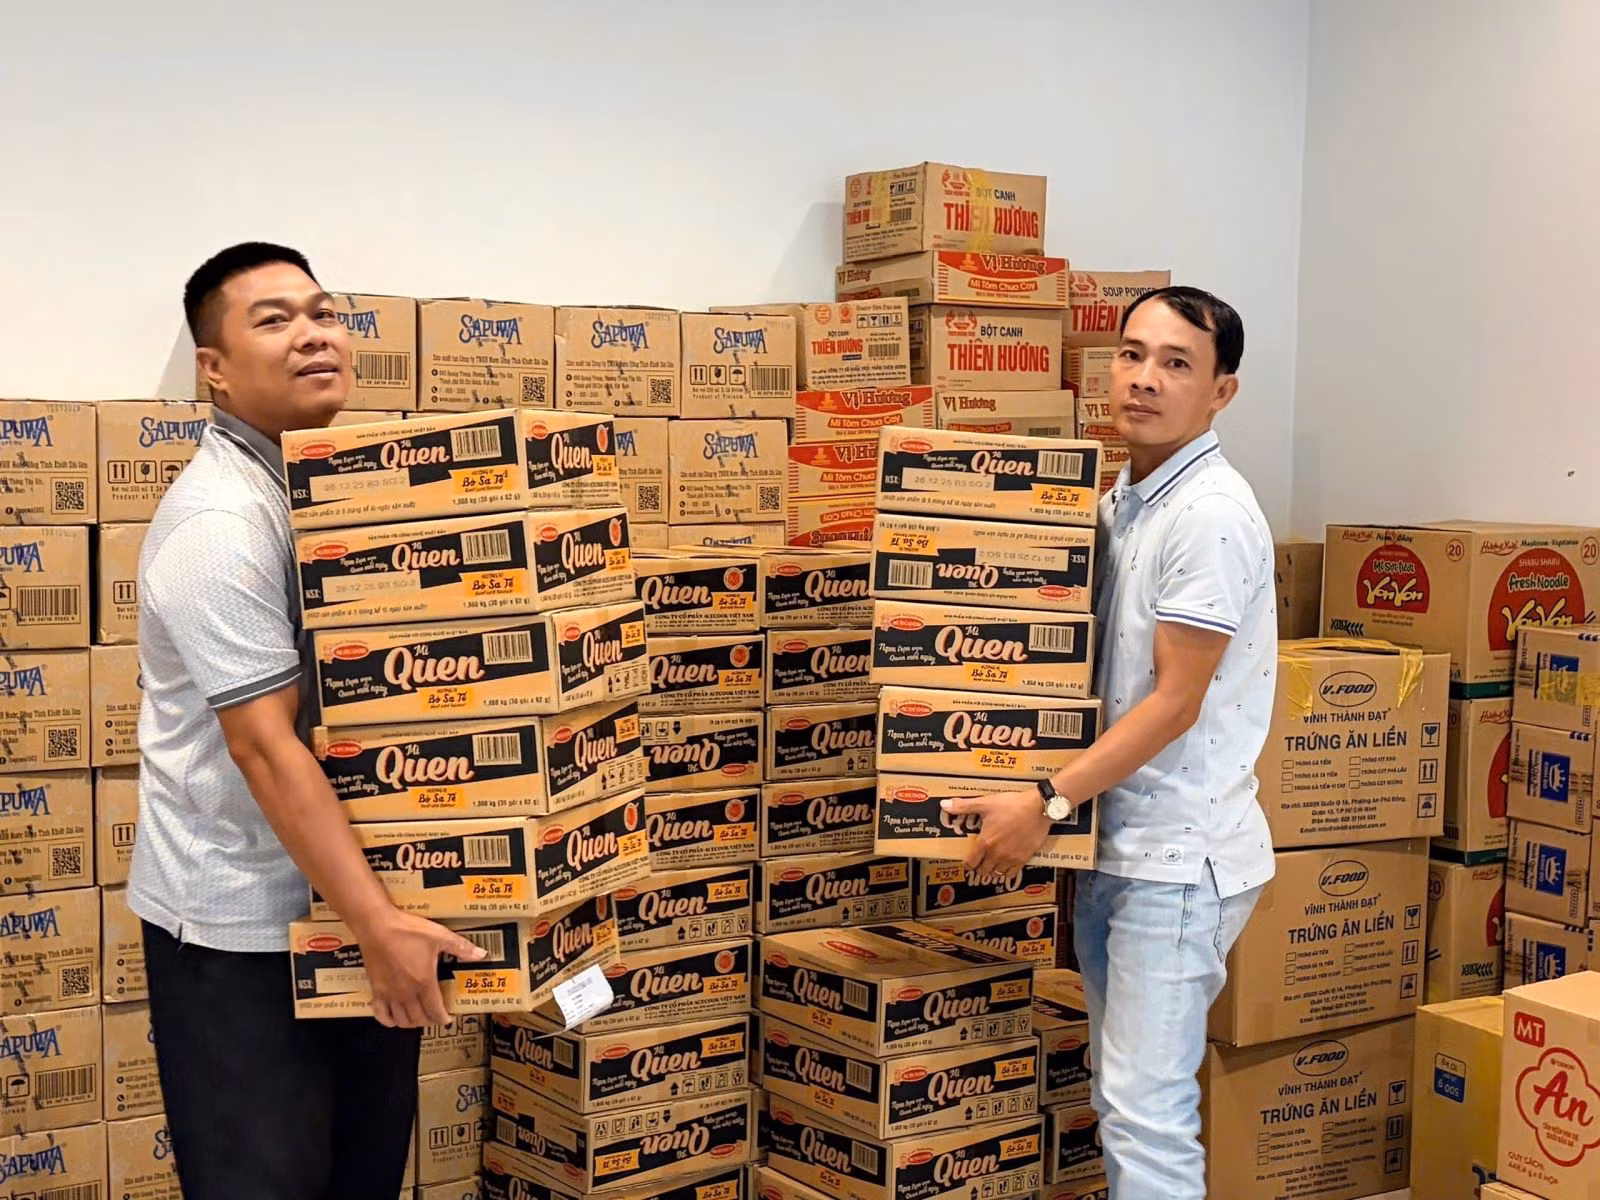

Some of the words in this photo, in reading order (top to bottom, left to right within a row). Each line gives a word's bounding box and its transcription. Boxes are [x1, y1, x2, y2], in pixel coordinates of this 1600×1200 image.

[994, 190, 1015, 201] CANH
[994, 203, 1039, 238] HƯƠNG
[981, 254, 998, 273] Vị
[982, 280, 997, 289] Tôm
[999, 282, 1019, 290] Chua
[1020, 282, 1035, 290] Cay
[1103, 287, 1123, 296] SOUP
[336, 311, 381, 340] PUWA
[459, 314, 522, 345] SAPUWA
[980, 323, 997, 337] BỘT
[1000, 326, 1022, 337] CANH
[1070, 300, 1118, 331] THIÊN
[591, 320, 649, 349] SAPUWA
[713, 327, 768, 354] SAPUWA
[947, 338, 994, 372] THIÊN
[998, 341, 1049, 372] HƯƠNG
[840, 390, 860, 409] Vị
[843, 418, 860, 427] Tôm
[861, 418, 882, 427] Chua
[884, 415, 901, 424] Cay
[380, 441, 450, 473] Quen
[551, 433, 593, 475] Quen
[703, 432, 759, 459] SAPUWA
[835, 473, 852, 481] Tôm
[970, 450, 1034, 477] Quen
[1056, 492, 1067, 501] Sa
[391, 543, 461, 575] Quen
[561, 532, 605, 574] Quen
[1449, 545, 1461, 556] 20
[1584, 544, 1596, 558] 20
[488, 579, 501, 589] Sa
[804, 570, 870, 601] Quen
[935, 563, 999, 589] Quen
[1538, 573, 1569, 591] Noodle
[641, 576, 712, 609] Quen
[583, 631, 623, 673] Quen
[935, 625, 1029, 664] Quen
[384, 646, 485, 692] Quen
[649, 655, 718, 689] Quen
[810, 646, 870, 680] Quen
[971, 669, 984, 678] Bò
[985, 669, 997, 678] Sa
[443, 693, 456, 703] Sa
[1322, 684, 1374, 695] V.FOOD
[943, 711, 1037, 750] Quen
[1331, 711, 1367, 723] THÀNH
[1369, 711, 1388, 721] ĐẠT
[574, 731, 617, 772] Quen
[811, 723, 875, 754] Quen
[1285, 731, 1340, 752] TRỨNG
[1346, 730, 1368, 748] ĂN
[1373, 725, 1407, 747] LIỀN
[376, 745, 475, 791] Quen
[650, 738, 720, 771] Quen
[980, 755, 992, 764] Bò
[994, 756, 1005, 764] Sa
[433, 793, 445, 803] Sa
[806, 797, 872, 829] Quen
[647, 813, 714, 847] Quen
[396, 843, 462, 874] Quen
[566, 829, 618, 871] Quen
[488, 883, 501, 893] Sa
[805, 872, 869, 901] Quen
[1321, 871, 1367, 886] V.FOOD
[638, 891, 708, 925] Quen
[1304, 902, 1326, 916] VĨNH
[1328, 898, 1359, 912] THÀNH
[1361, 897, 1378, 910] ĐẠT
[0, 908, 61, 939] APUWA
[1288, 923, 1337, 944] TRỨNG
[1342, 918, 1360, 937] ĂN
[1365, 910, 1394, 933] LIỀN
[553, 922, 593, 963] Quen
[630, 967, 703, 999] Quen
[792, 968, 843, 1011] Quen
[923, 992, 991, 1026] Quen
[1517, 1017, 1543, 1042] MT
[514, 1027, 554, 1070] Quen
[1296, 1050, 1346, 1066] V.FOOD
[630, 1047, 702, 1082] Quen
[794, 1048, 846, 1092] Quen
[927, 1071, 994, 1106] Quen
[1305, 1080, 1337, 1092] THÀNH
[1340, 1075, 1359, 1088] ĐẠT
[1533, 1071, 1594, 1126] An
[1260, 1103, 1314, 1125] TRỨNG
[1319, 1098, 1339, 1116] ĂN
[1345, 1088, 1377, 1111] LIỀN
[639, 1123, 710, 1155] Quen
[800, 1126, 851, 1174] Quen
[933, 1153, 1000, 1188] Quen
